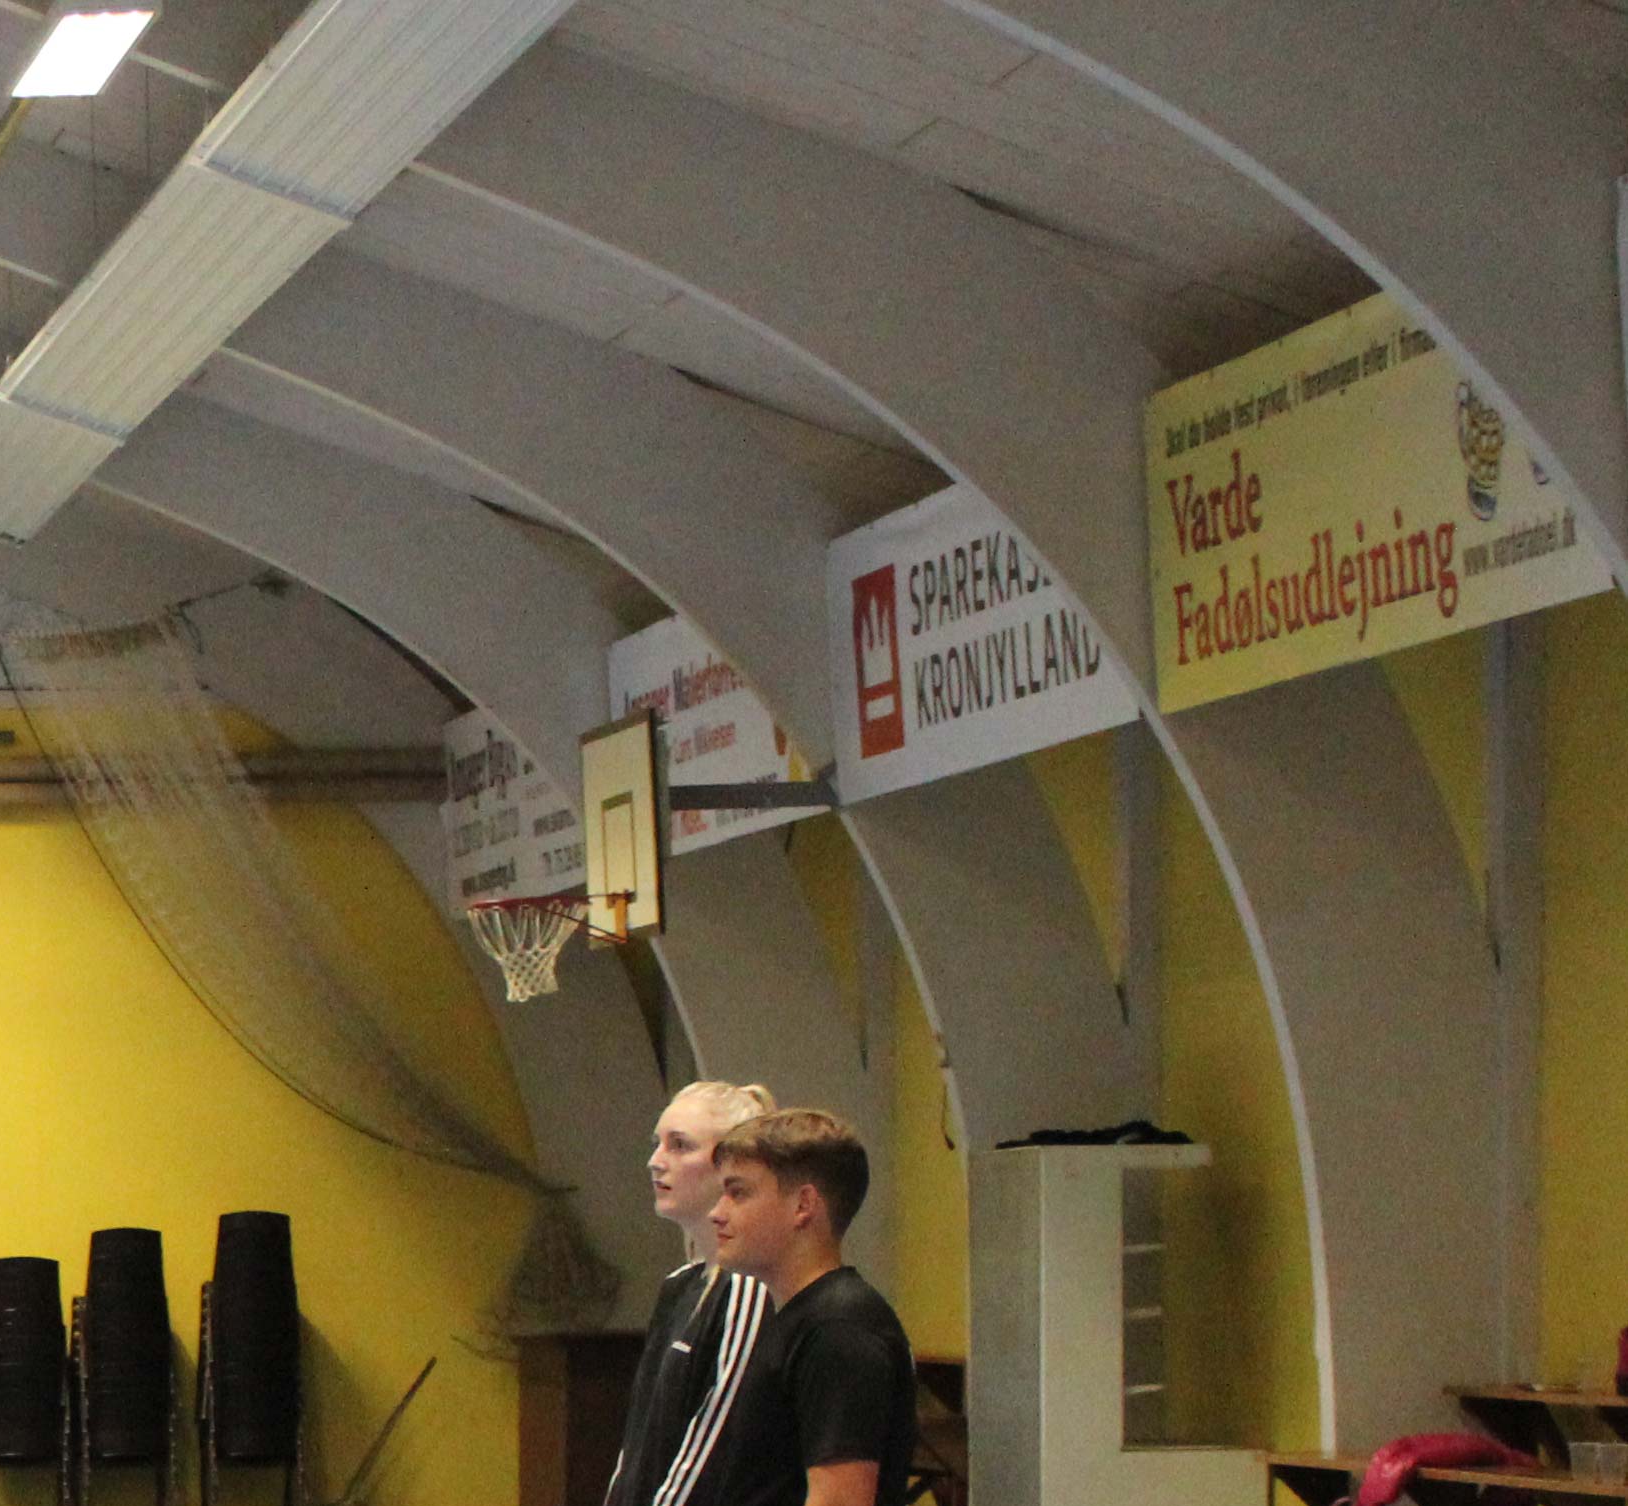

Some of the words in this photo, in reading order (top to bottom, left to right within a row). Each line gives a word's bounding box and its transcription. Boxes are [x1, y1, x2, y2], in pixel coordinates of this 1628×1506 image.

[1165, 449, 1263, 558] Varde
[1173, 506, 1460, 666] Fadølsudlejning
[914, 608, 1101, 728] KRONJYLLAND
